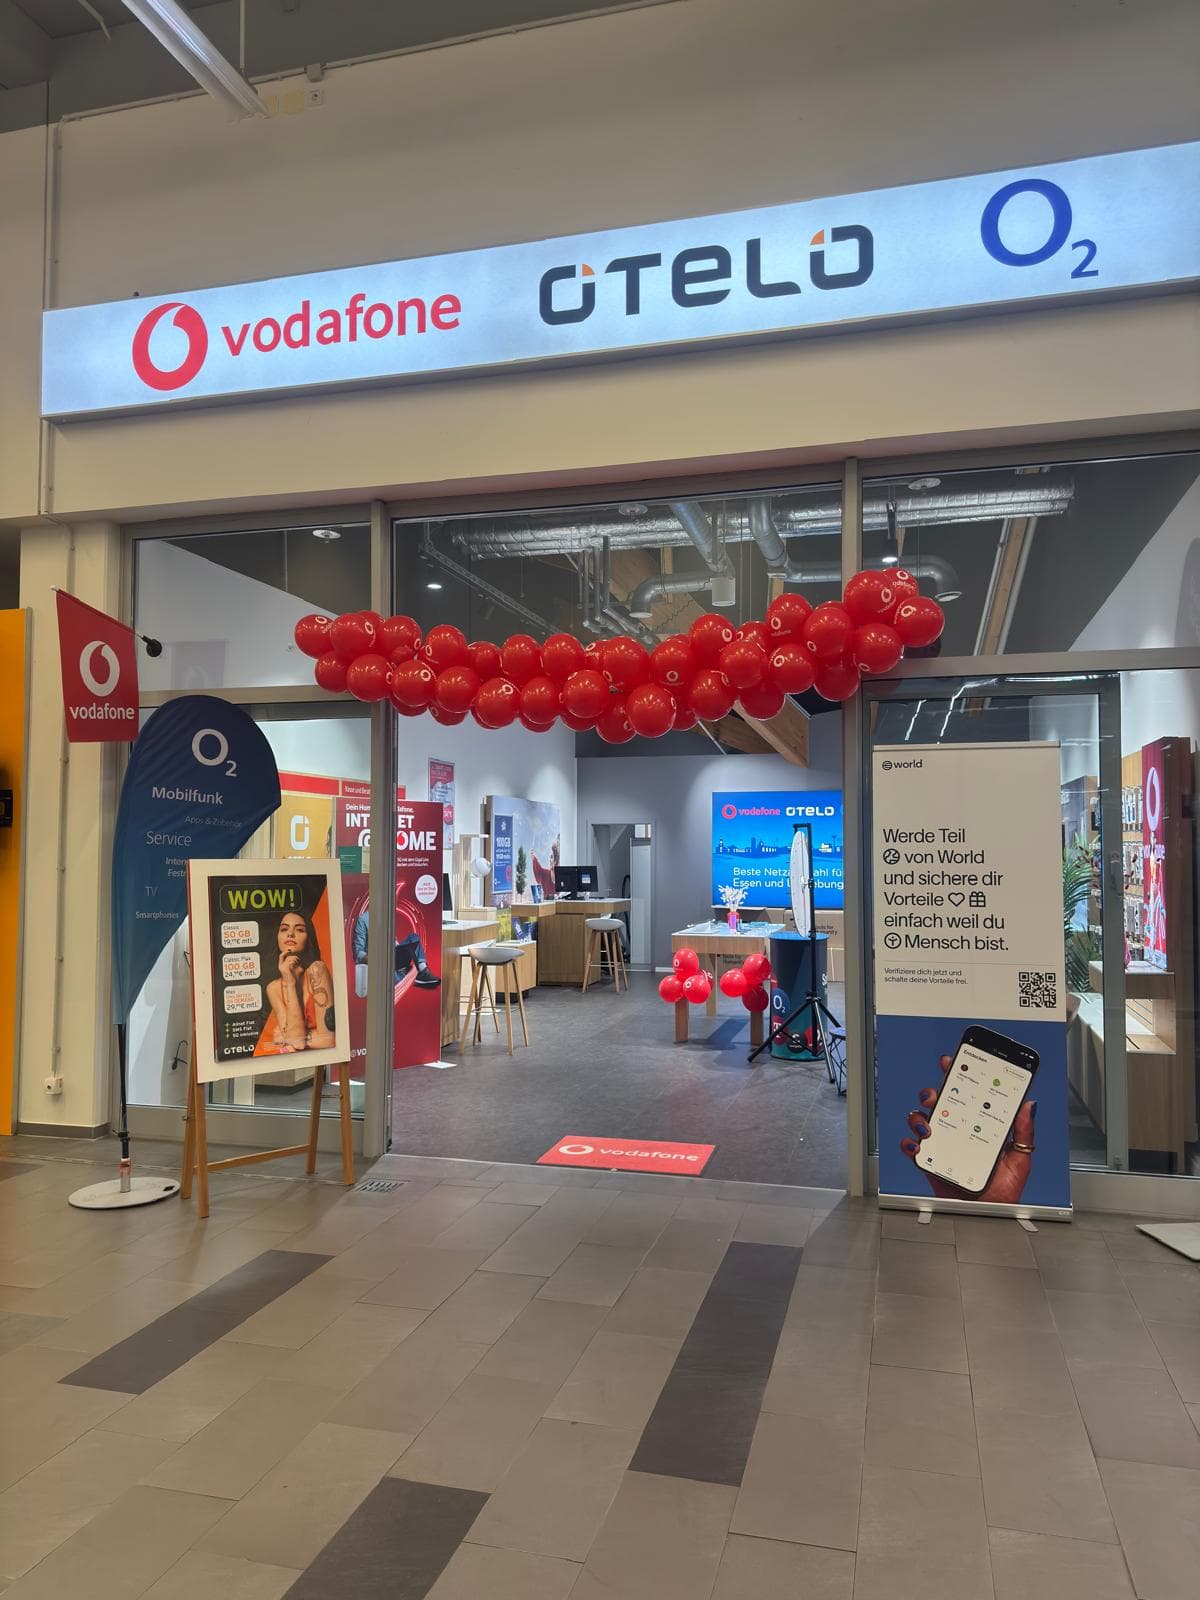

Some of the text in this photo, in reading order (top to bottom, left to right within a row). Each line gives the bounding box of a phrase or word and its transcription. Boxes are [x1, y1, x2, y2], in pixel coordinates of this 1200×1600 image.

[221, 293, 462, 356] vodafone
[69, 704, 135, 721] vodafone
[894, 759, 923, 769] world
[152, 786, 224, 805] Mobilfunk
[738, 806, 781, 816] vodafone
[146, 830, 192, 847] Service
[882, 828, 966, 844] Werde Teil
[904, 850, 985, 864] von World
[733, 867, 761, 877] Beste
[884, 870, 1004, 886] und sichere dir
[733, 878, 762, 888] Essen
[764, 878, 784, 888] und
[145, 886, 158, 898] TV
[228, 888, 296, 910] WOW!
[884, 891, 945, 907] Vorteile
[135, 911, 180, 920] Smartphones
[884, 912, 1006, 930] einfach weil du
[224, 930, 251, 939] 50 GB
[904, 934, 1010, 952] Mensch bist.
[224, 962, 256, 971] 100 GB
[884, 968, 963, 978] Verifiziere dich jetzt und
[884, 976, 908, 984] schalte
[908, 976, 928, 984] deine
[928, 976, 954, 985] Vorteile
[600, 1148, 700, 1162] vodafone
